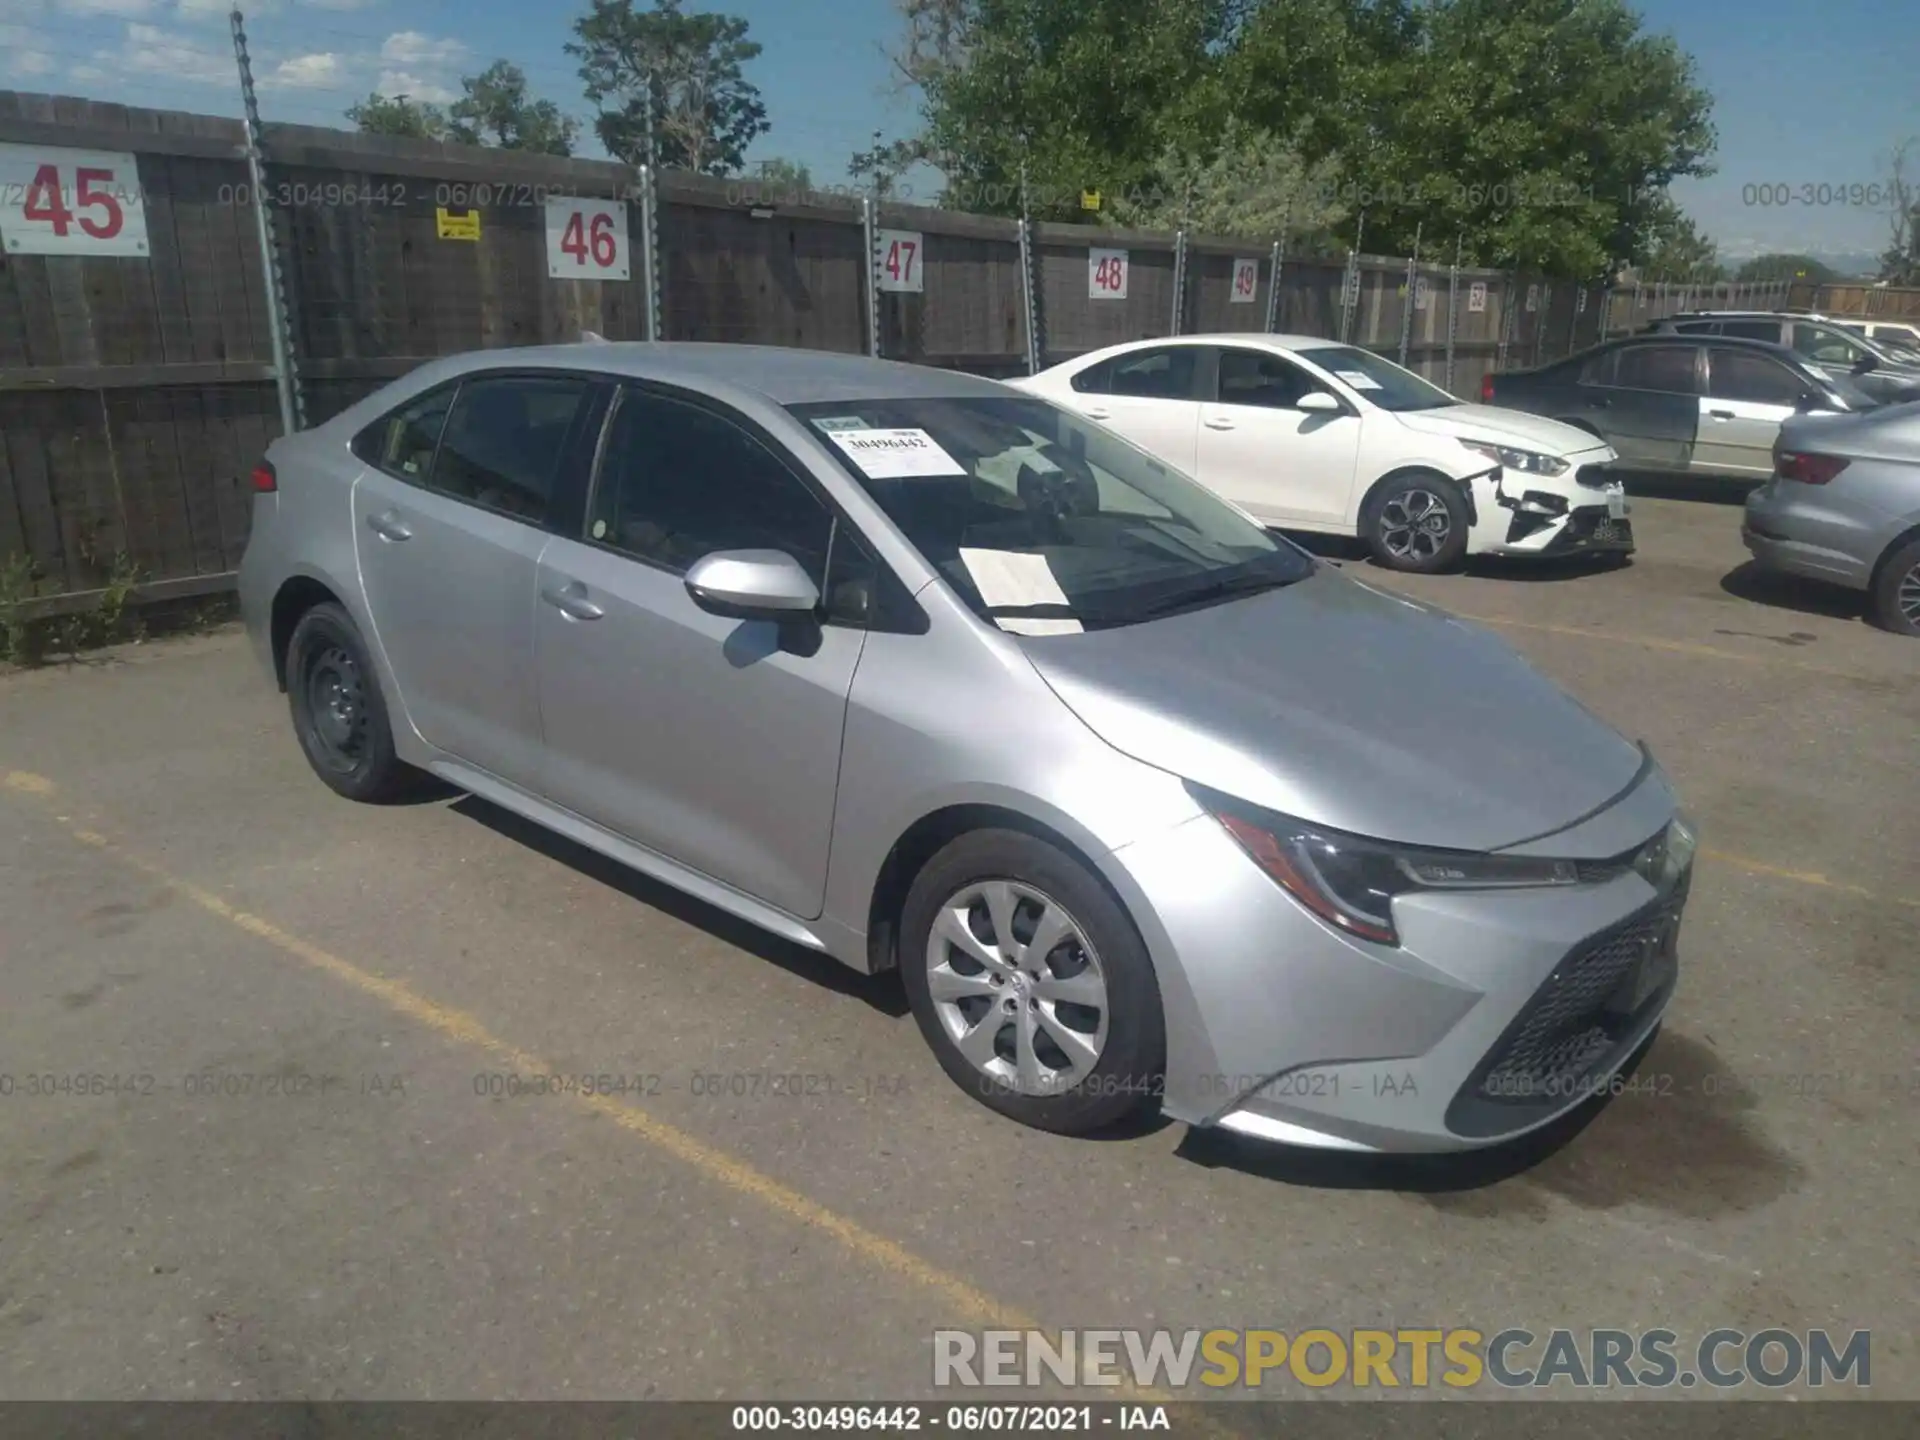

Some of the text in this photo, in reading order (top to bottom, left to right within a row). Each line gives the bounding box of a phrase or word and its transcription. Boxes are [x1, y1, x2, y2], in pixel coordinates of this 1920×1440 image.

[24, 164, 123, 239] 45
[561, 212, 616, 267] 46
[885, 240, 916, 282] 47
[1095, 257, 1122, 291] 48
[1236, 266, 1253, 295] 49
